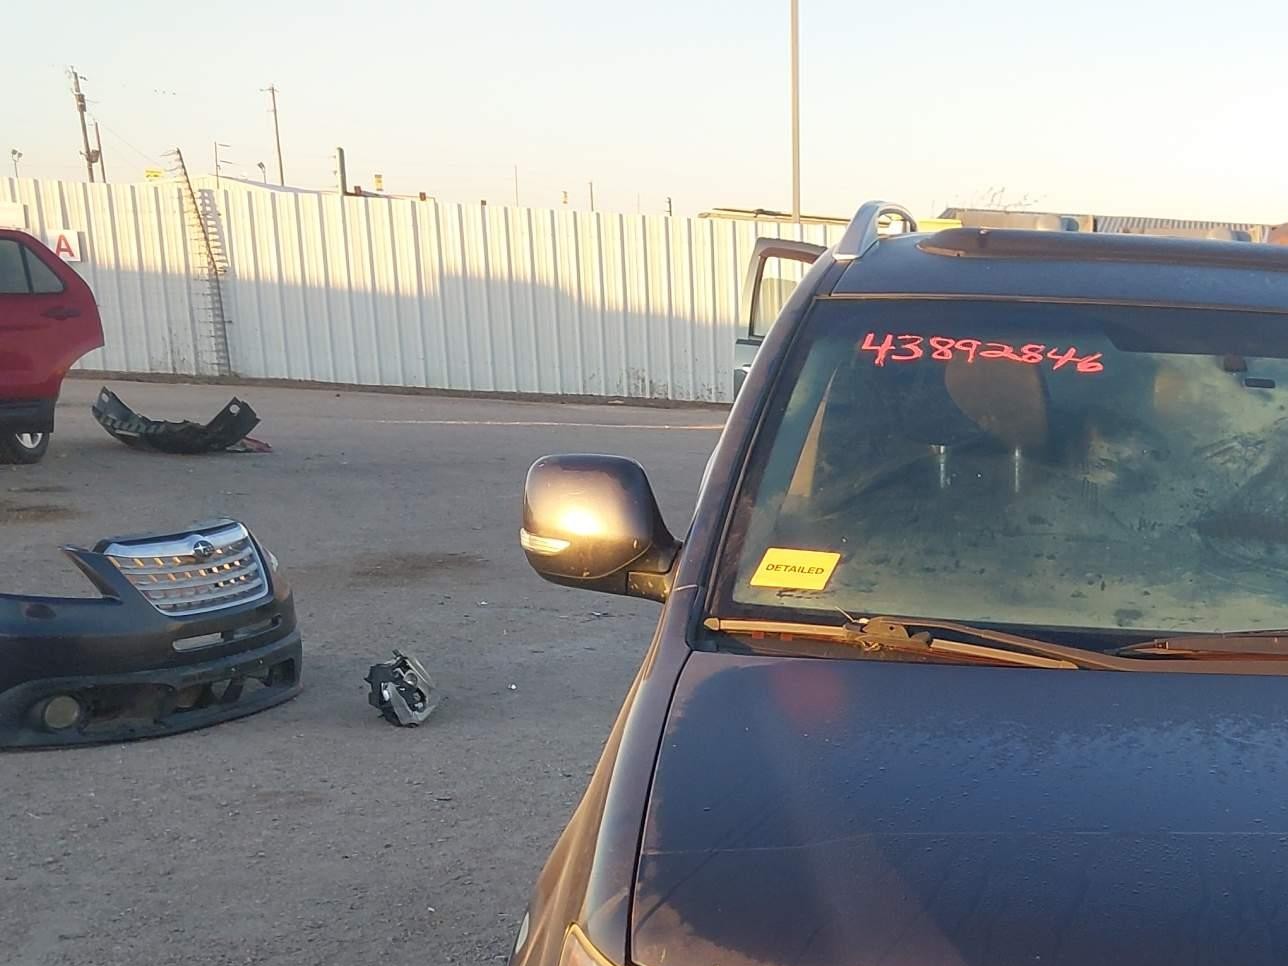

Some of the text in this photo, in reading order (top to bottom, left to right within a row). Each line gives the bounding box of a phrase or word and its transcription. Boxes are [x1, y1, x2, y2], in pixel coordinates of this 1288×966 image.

[56, 234, 75, 257] A
[861, 333, 1104, 372] 43892846
[766, 563, 825, 575] DETAILED
